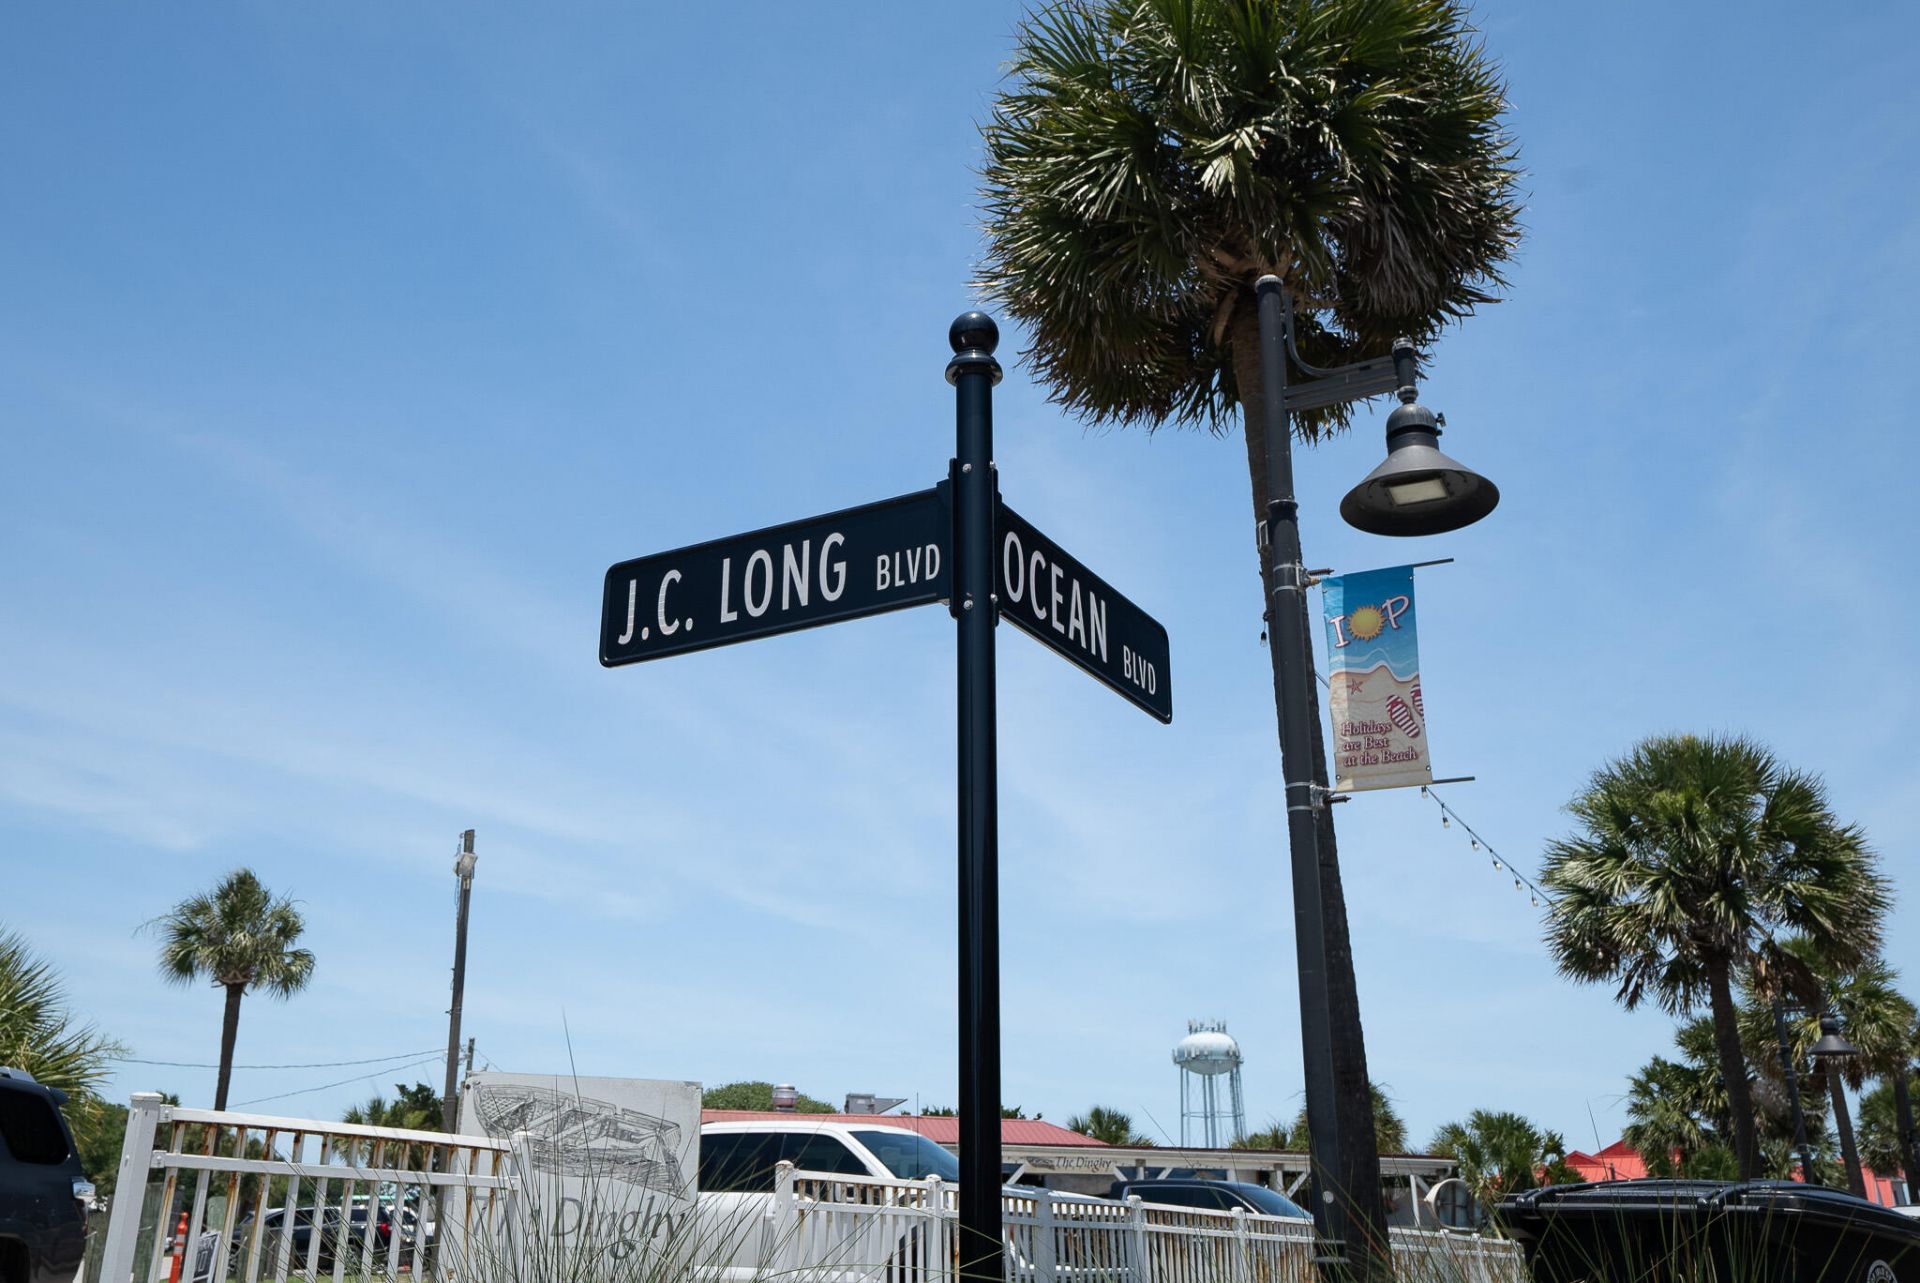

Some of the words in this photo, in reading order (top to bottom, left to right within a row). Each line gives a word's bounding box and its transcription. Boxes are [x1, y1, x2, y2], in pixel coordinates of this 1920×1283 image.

[618, 569, 693, 645] J.C.
[720, 532, 847, 624] LONG
[876, 543, 941, 591] BLVD
[1003, 531, 1108, 664] OCEAN
[1123, 644, 1156, 695] BLVD
[1341, 719, 1392, 736] Holidays
[1342, 740, 1361, 752] are
[1364, 735, 1389, 750] Best
[1343, 755, 1358, 768] at
[1359, 751, 1378, 766] the
[1381, 745, 1419, 764] Beach
[1055, 1156, 1074, 1170] The
[1075, 1156, 1112, 1173] Dinghy
[550, 1195, 687, 1260] Dnghy
